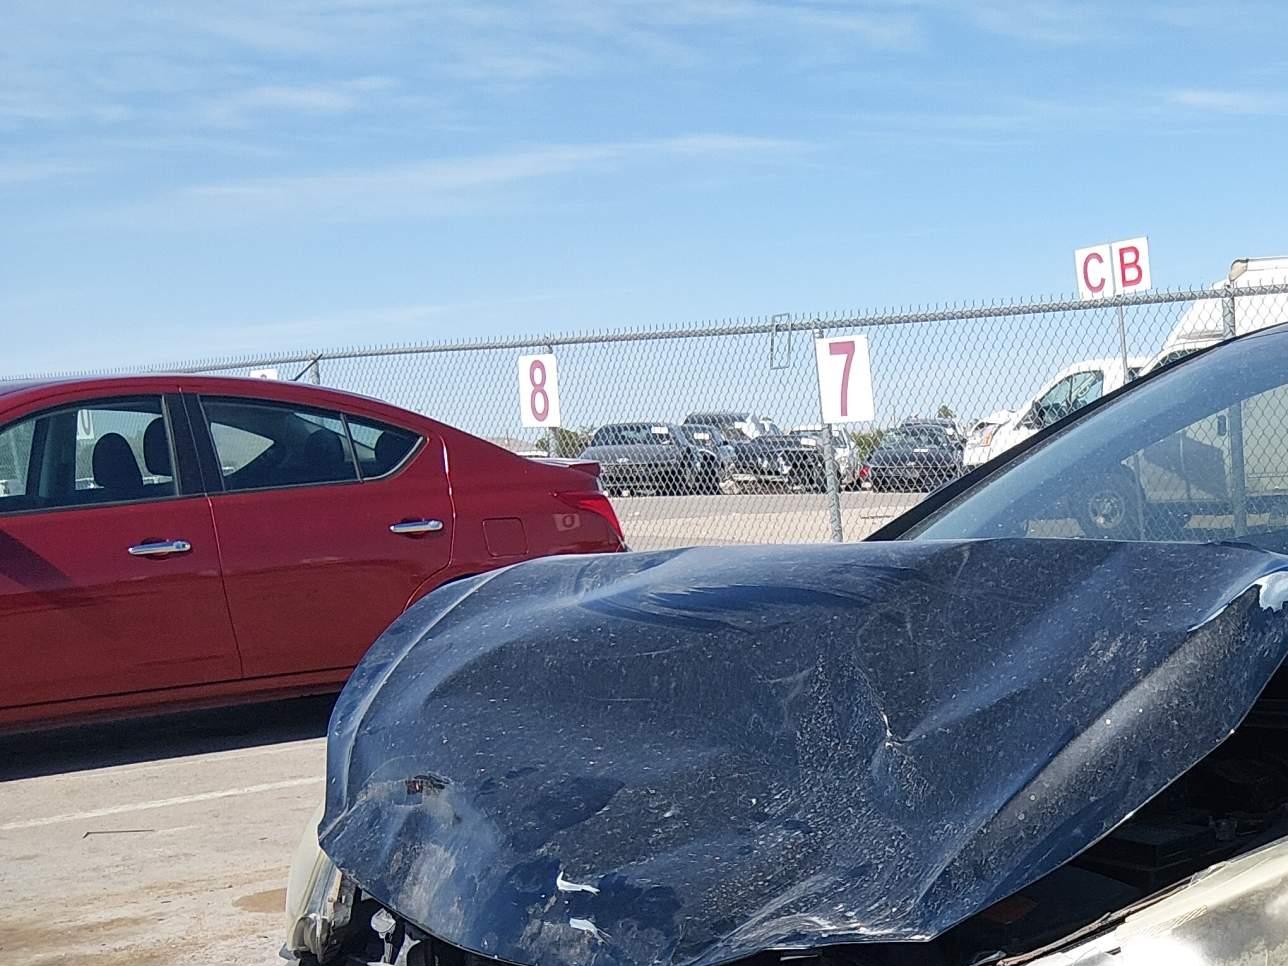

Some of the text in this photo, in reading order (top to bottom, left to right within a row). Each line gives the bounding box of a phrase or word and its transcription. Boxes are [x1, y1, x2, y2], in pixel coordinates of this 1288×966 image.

[1083, 246, 1144, 292] C B
[529, 359, 549, 422] 8
[829, 341, 856, 416] 7
